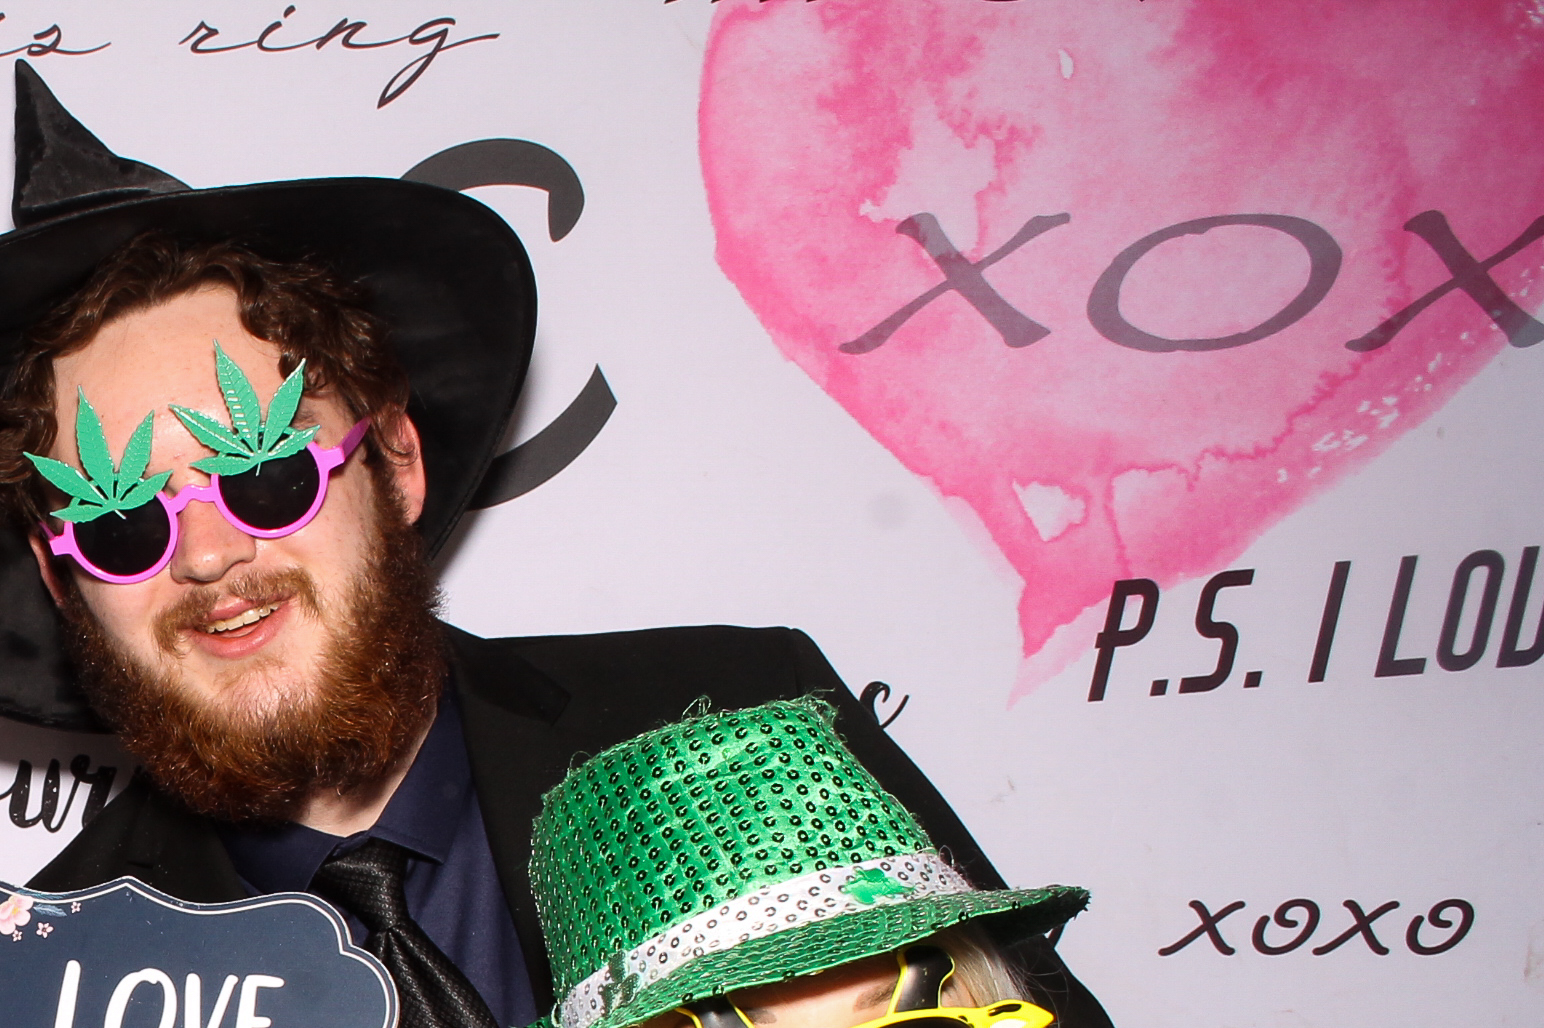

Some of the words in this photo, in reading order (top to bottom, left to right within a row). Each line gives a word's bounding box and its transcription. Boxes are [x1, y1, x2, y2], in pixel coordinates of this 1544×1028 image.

[178, 5, 501, 110] ring
[1088, 568, 1263, 702] P.S.
[1308, 560, 1351, 683] I
